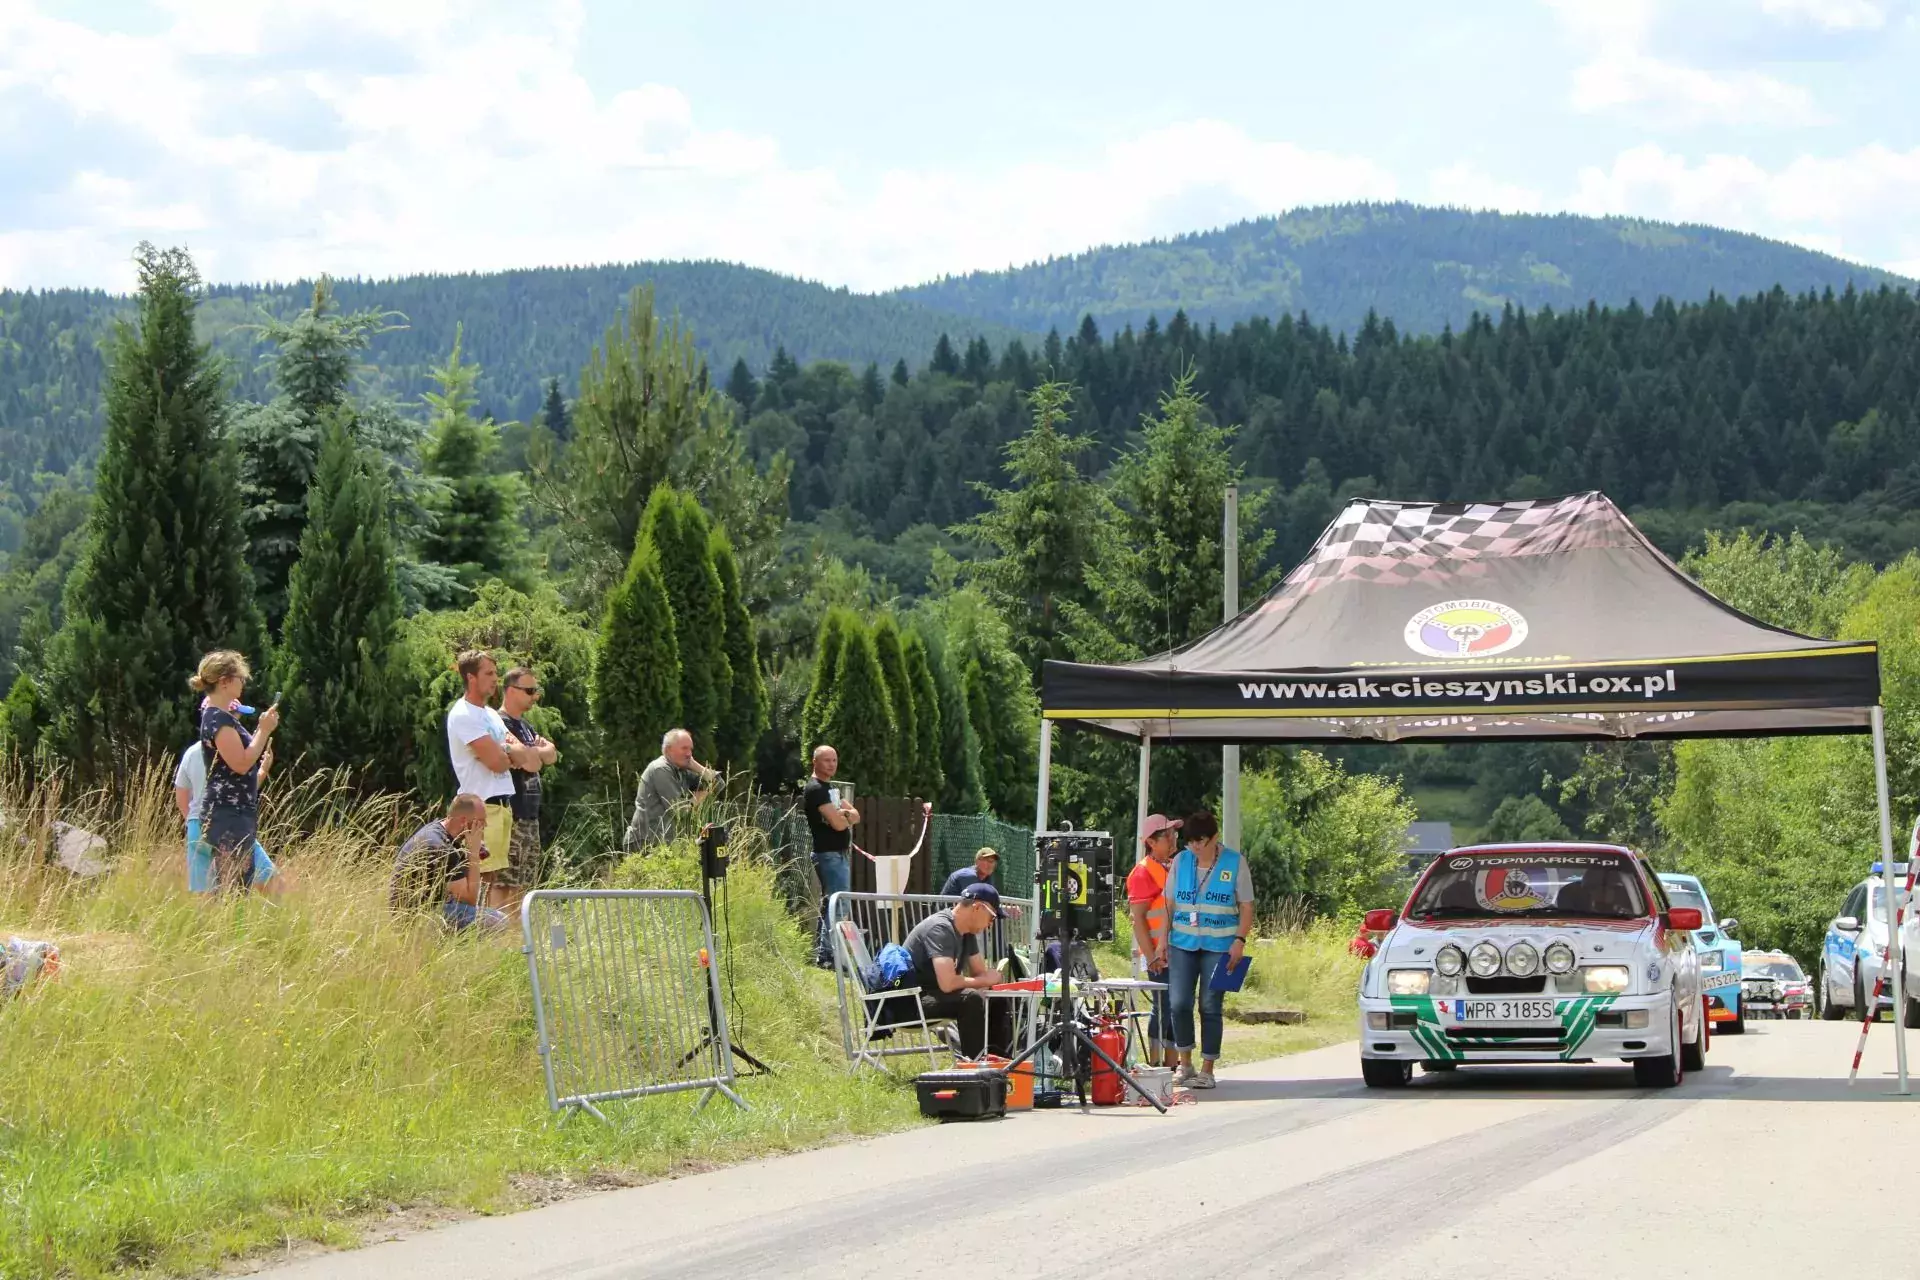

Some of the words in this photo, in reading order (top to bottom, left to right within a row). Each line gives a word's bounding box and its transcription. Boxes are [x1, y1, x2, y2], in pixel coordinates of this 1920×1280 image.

[1413, 600, 1525, 626] AUTOMOBILKLUB
[1238, 670, 1676, 702] www.ak-cieszynski.ox.pl
[1477, 856, 1620, 867] TOPMARKET.pl
[1205, 891, 1231, 903] CHIEF
[1465, 1002, 1496, 1018] WPR
